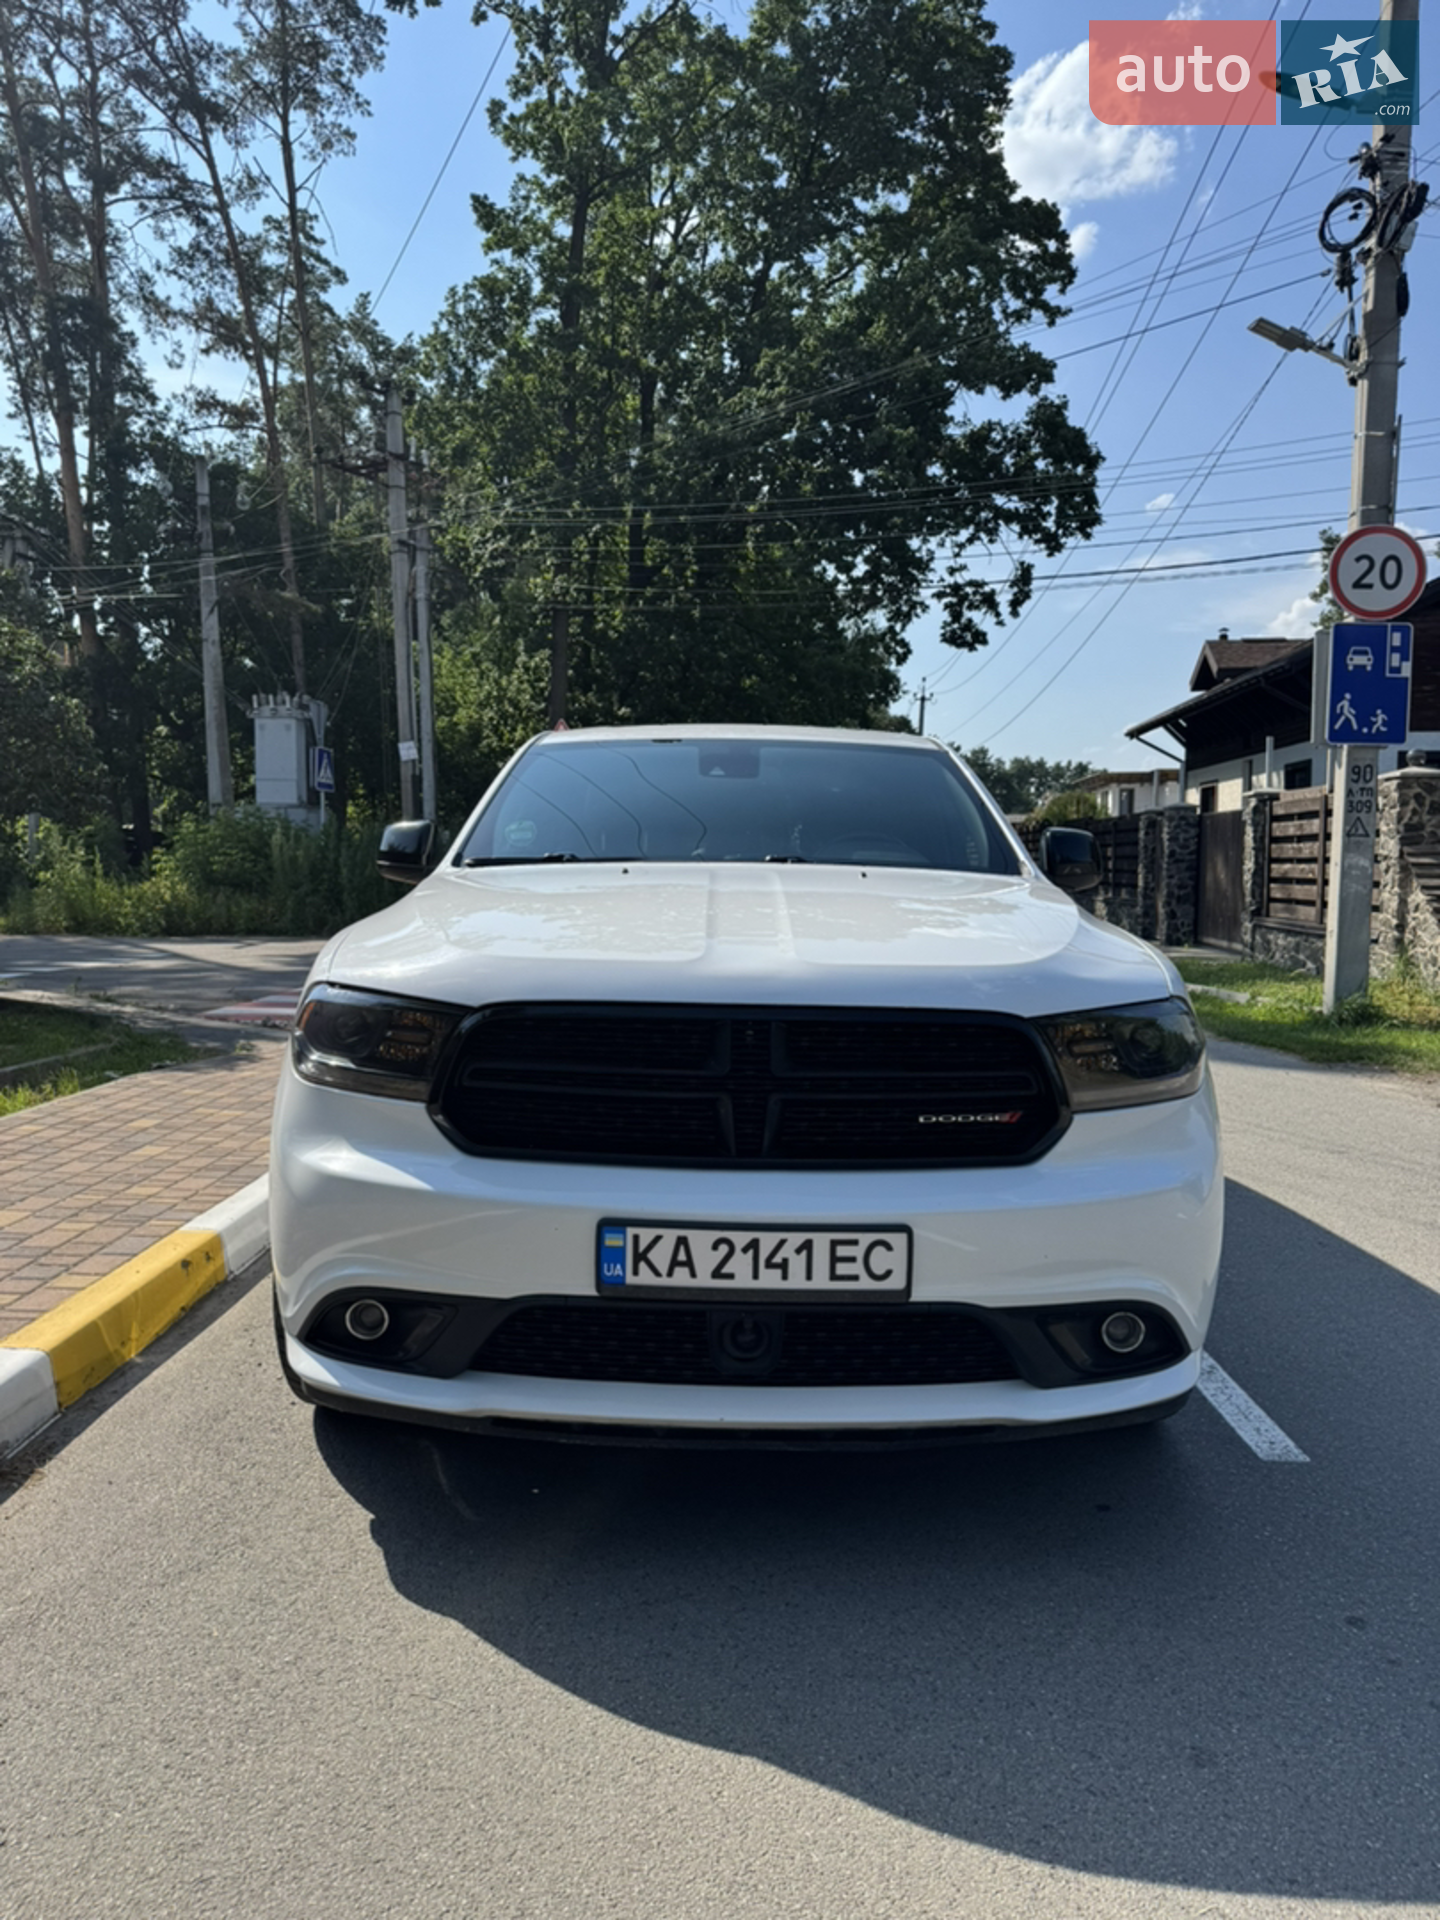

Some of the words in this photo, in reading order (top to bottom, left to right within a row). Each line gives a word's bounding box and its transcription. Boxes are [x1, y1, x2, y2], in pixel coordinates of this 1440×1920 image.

[1351, 554, 1403, 590] 20
[1351, 763, 1374, 784] 90
[1347, 799, 1373, 814] 309
[918, 1112, 1010, 1123] DODGE
[631, 1233, 697, 1278] KA
[710, 1236, 814, 1281] 2141
[828, 1238, 894, 1282] EC
[603, 1263, 623, 1277] UA
